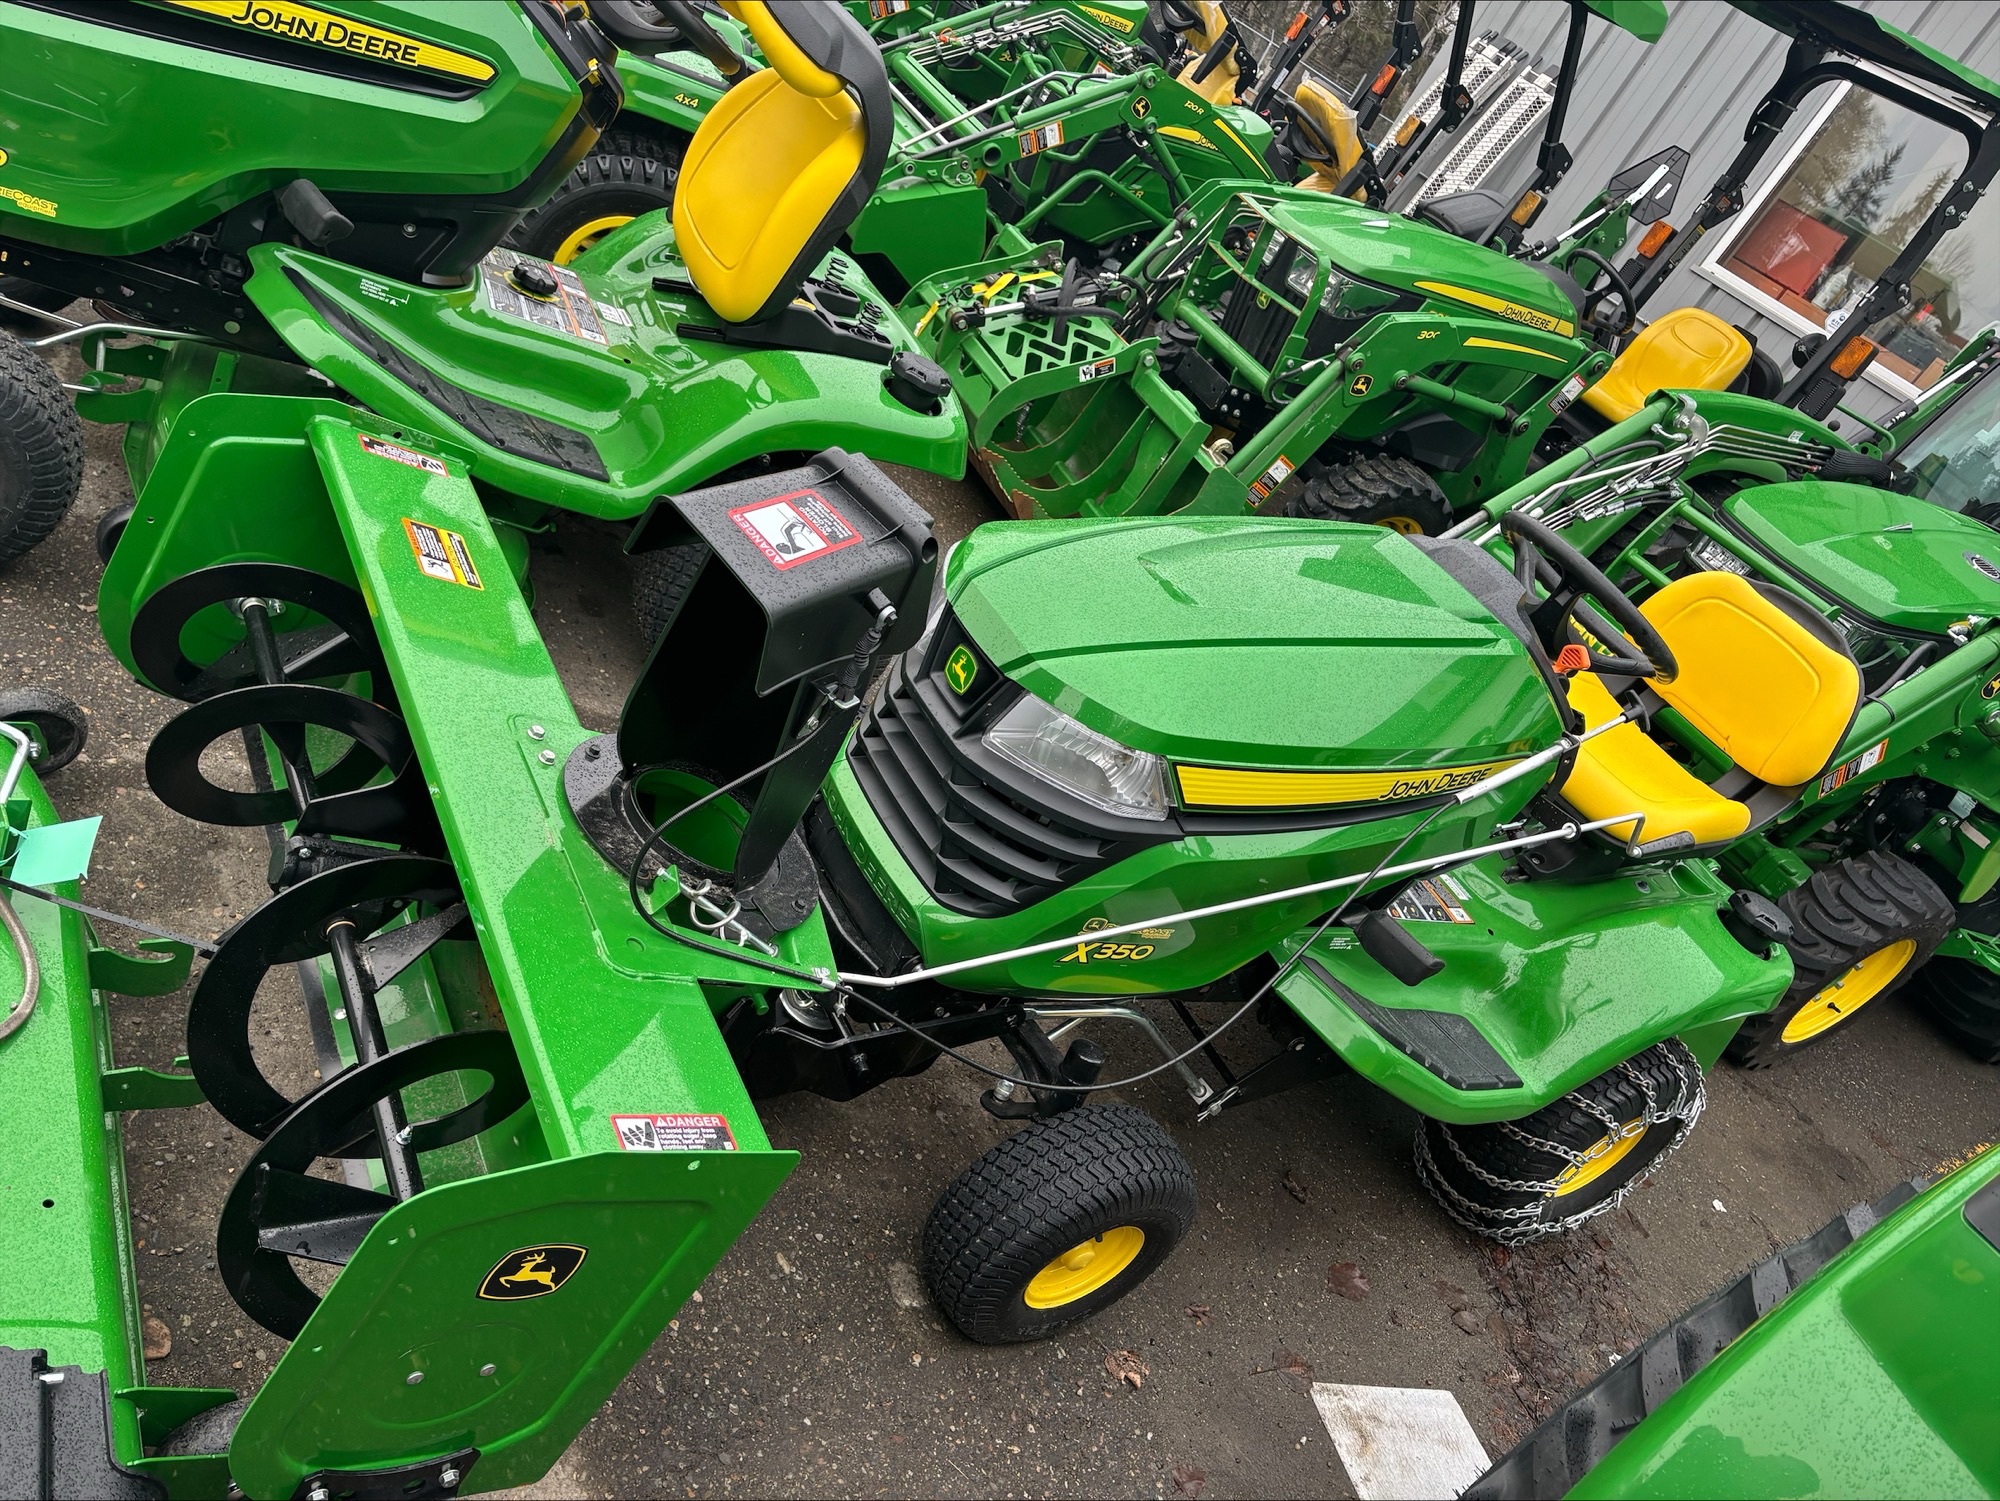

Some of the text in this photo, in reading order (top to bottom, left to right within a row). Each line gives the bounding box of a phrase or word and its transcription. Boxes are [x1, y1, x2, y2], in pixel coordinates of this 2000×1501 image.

[231, 2, 420, 65] JOHN DEERE
[1104, 16, 1129, 32] DEERE
[674, 93, 699, 108] 4x4
[1500, 304, 1552, 330] JOHN DEERE
[733, 514, 776, 557] DANGER
[1379, 766, 1493, 799] JOHN DEERE
[820, 779, 911, 929] JOHN DEERE
[1056, 941, 1155, 964] X350
[666, 1116, 721, 1128] DANGER
